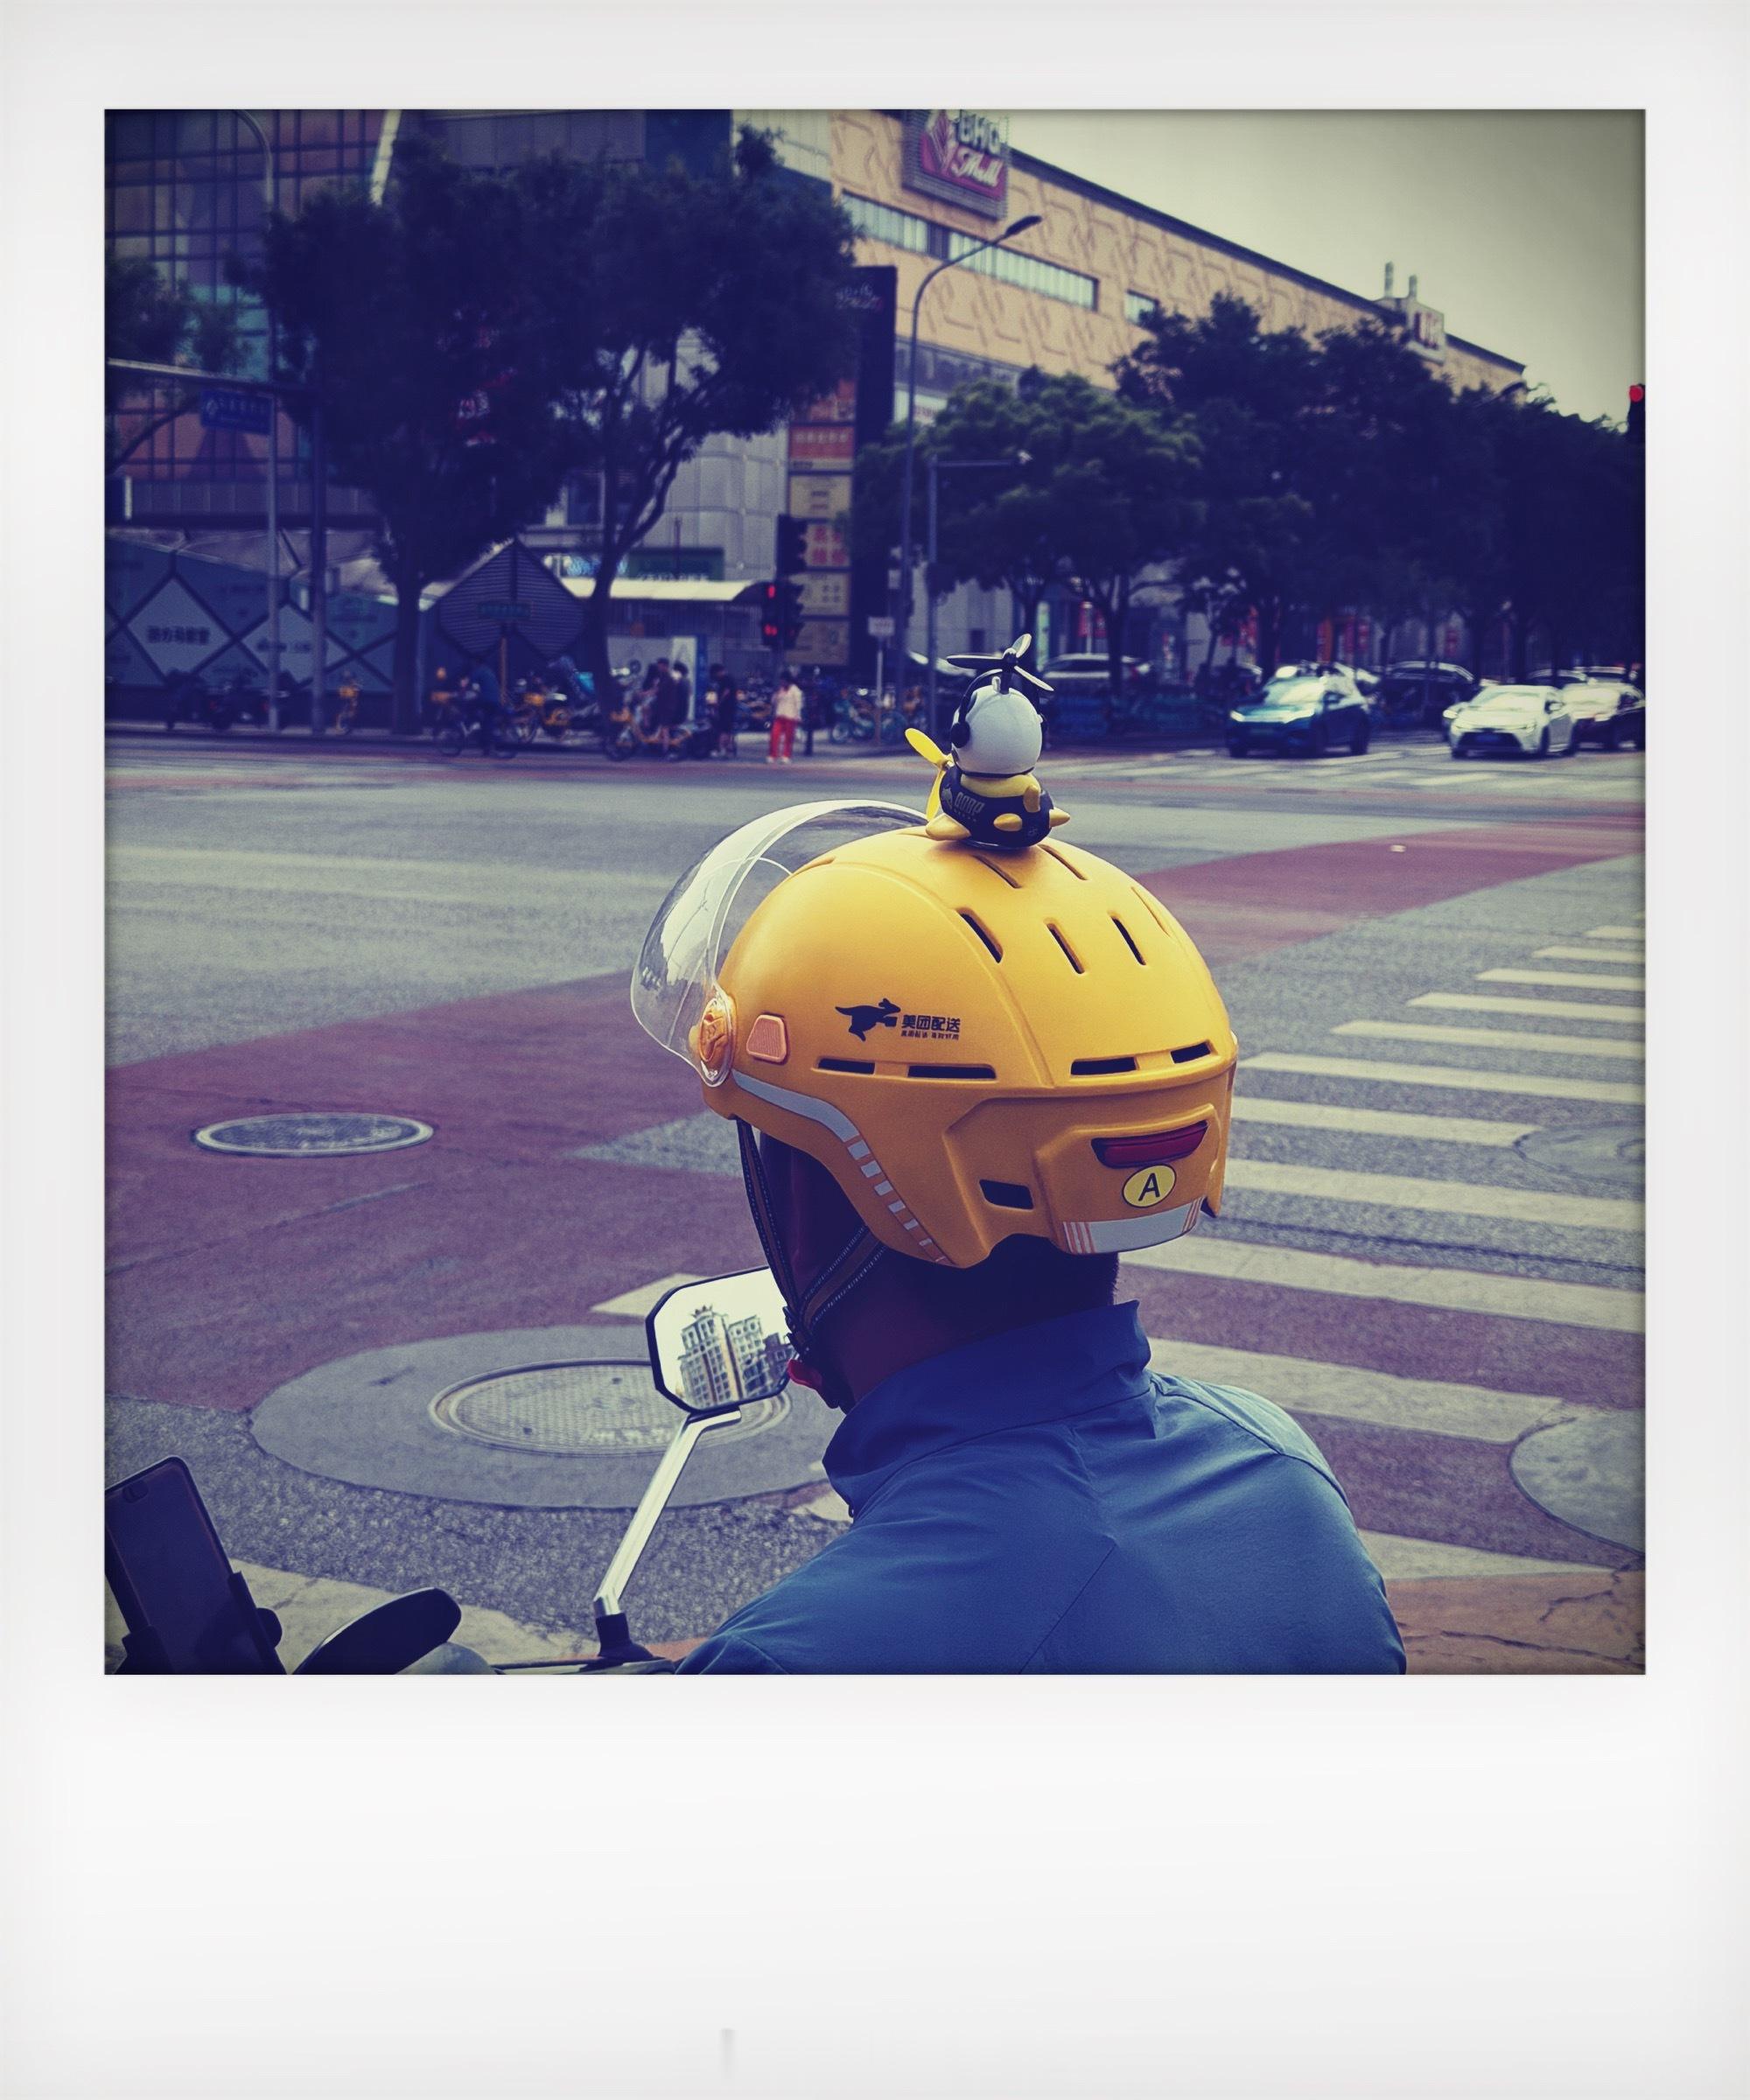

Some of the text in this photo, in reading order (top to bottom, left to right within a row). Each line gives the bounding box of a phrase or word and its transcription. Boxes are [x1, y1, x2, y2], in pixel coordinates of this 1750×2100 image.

[901, 1014, 961, 1033] 美团配送
[1138, 1172, 1160, 1202] A
